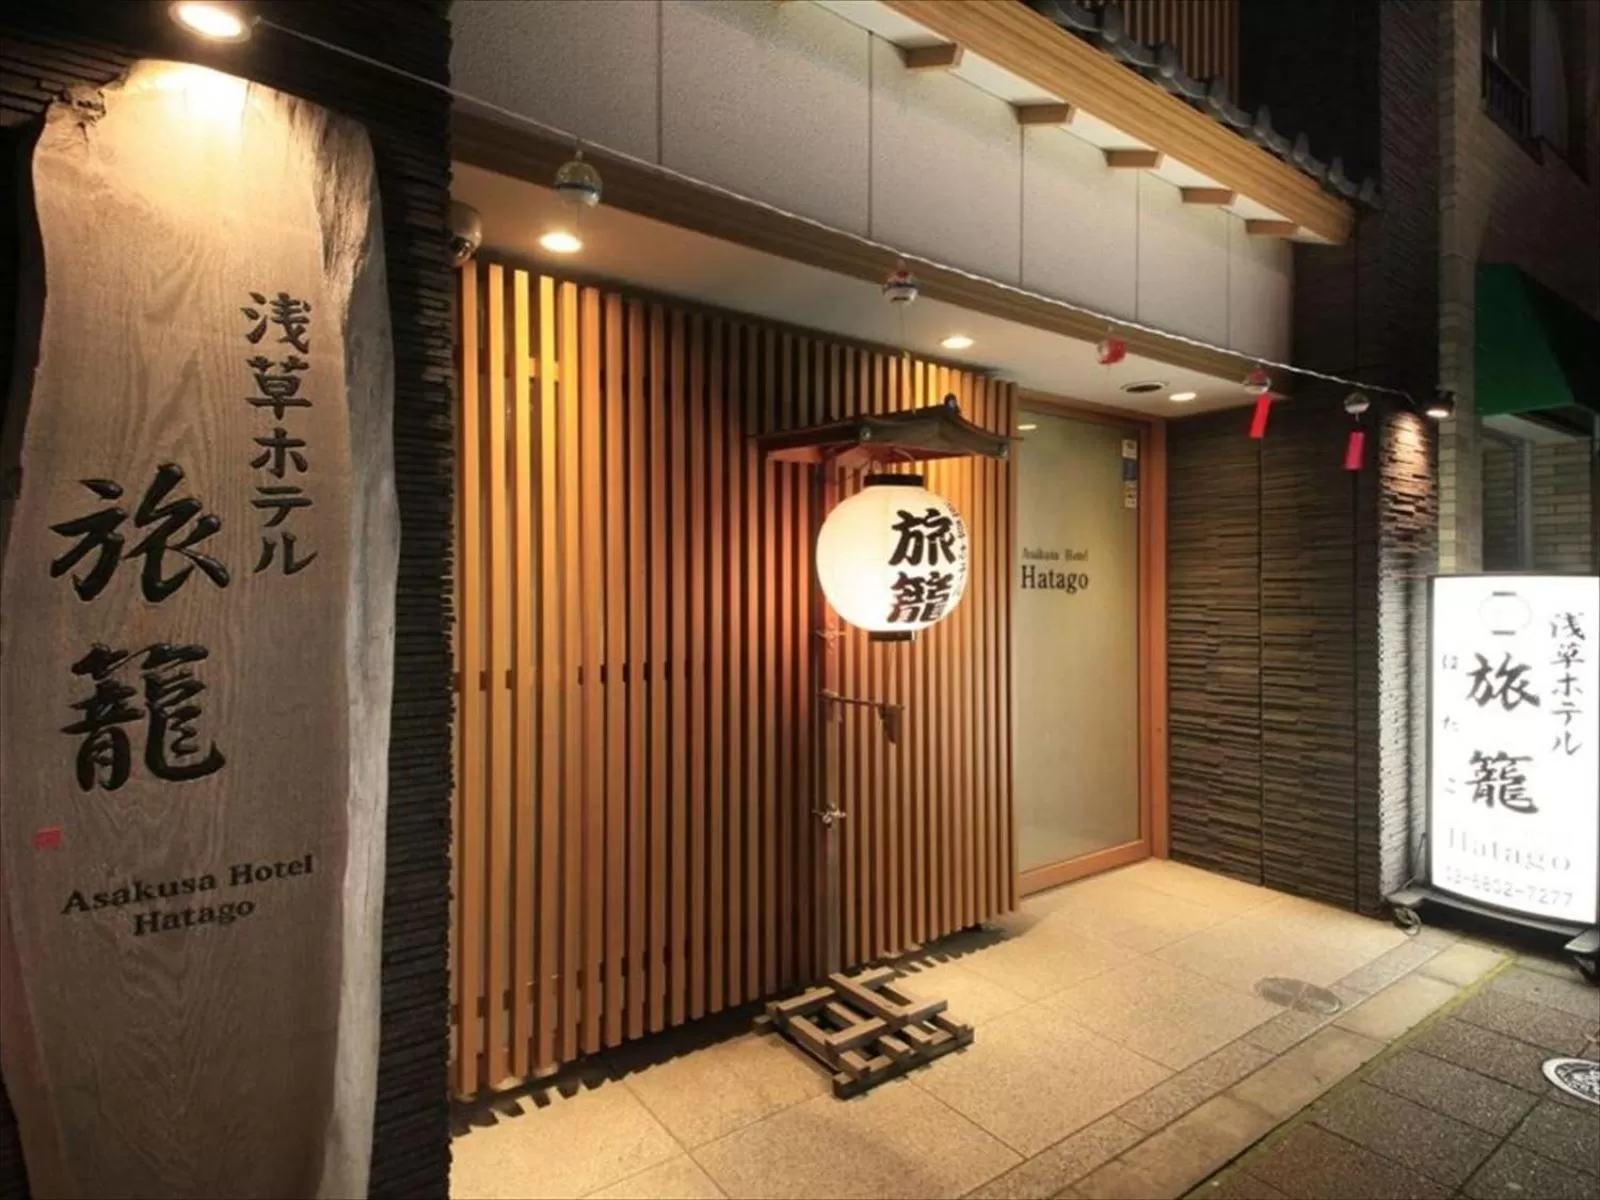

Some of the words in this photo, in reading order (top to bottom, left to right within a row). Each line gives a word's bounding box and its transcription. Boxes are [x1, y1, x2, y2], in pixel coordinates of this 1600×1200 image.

[241, 291, 318, 576] 浅草ホテル
[48, 463, 230, 792] 旅籠
[887, 507, 957, 623] 旅籠
[1021, 565, 1089, 594] Hatago
[1465, 652, 1541, 814] 旅籠
[1550, 612, 1586, 756] 浅草ホテル
[61, 873, 216, 914] Asakusa
[229, 854, 314, 886] Hotel
[133, 901, 256, 936] Hatago
